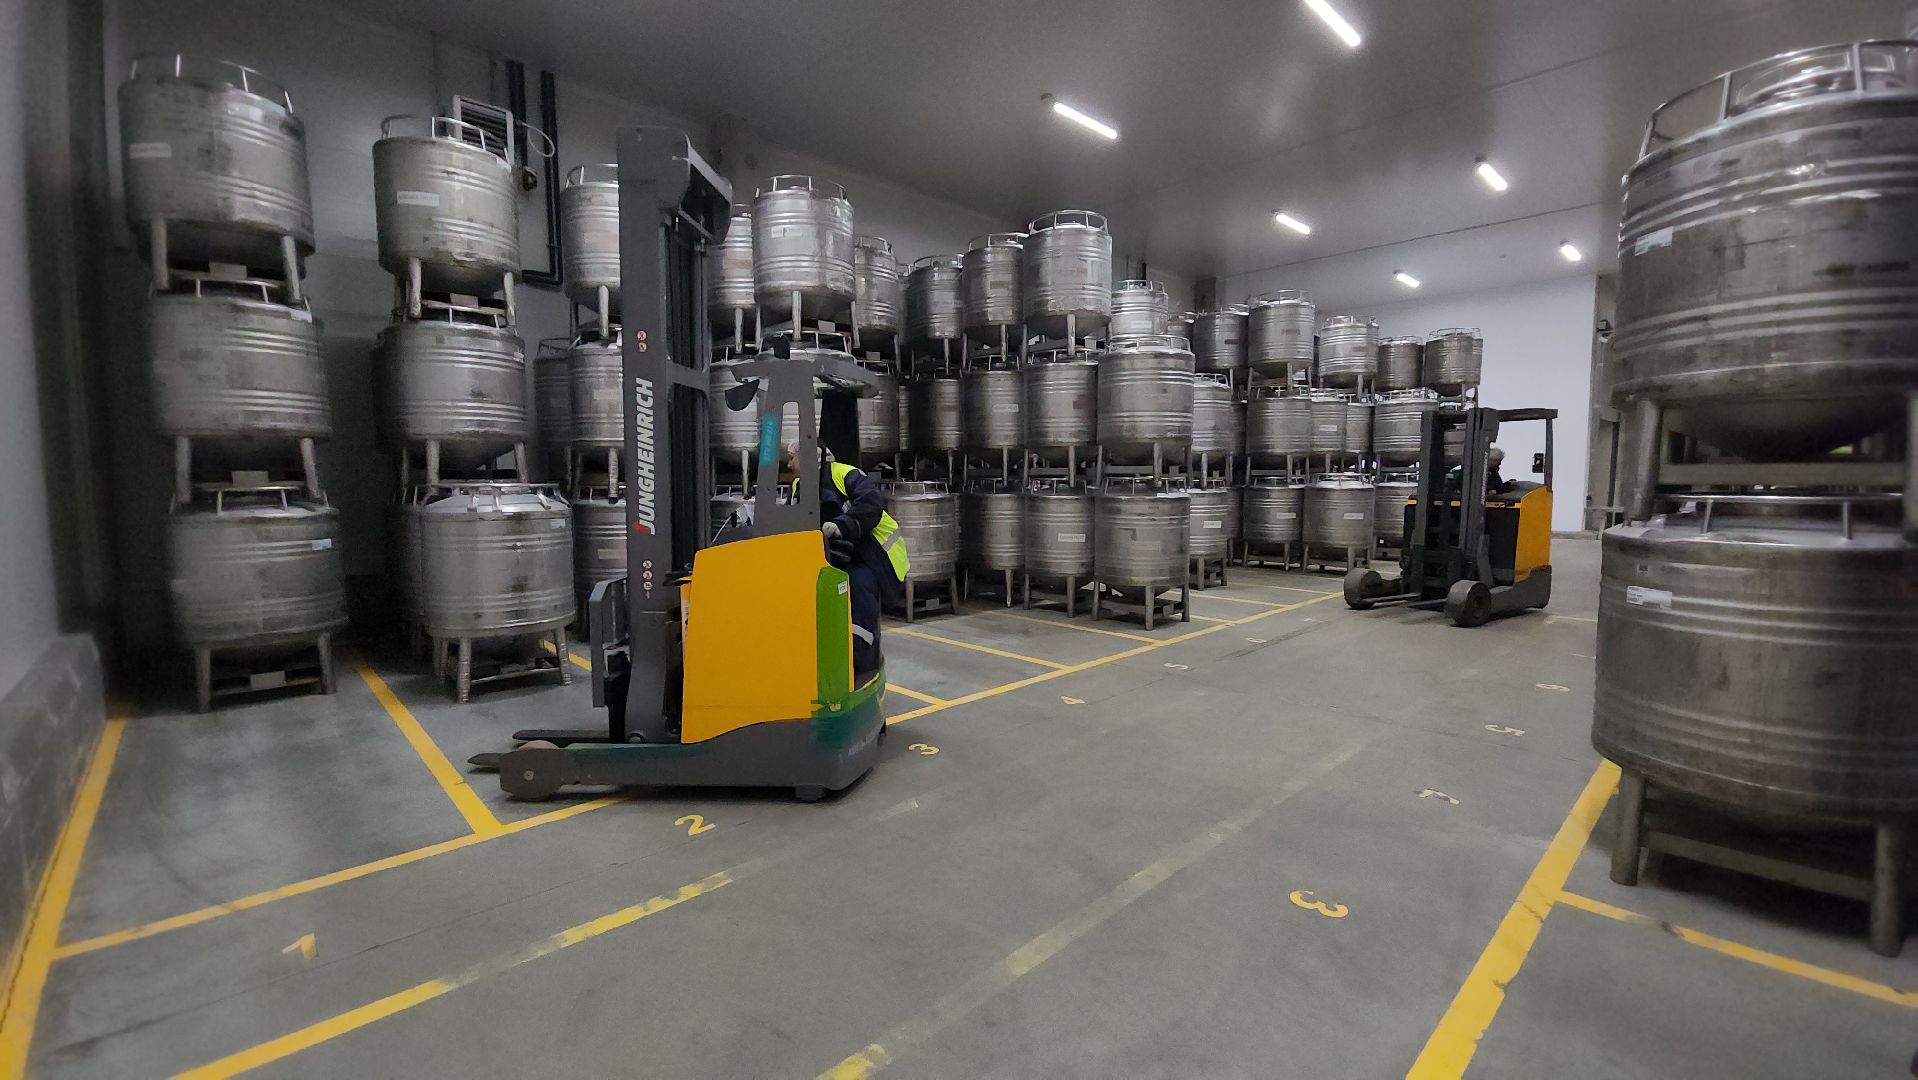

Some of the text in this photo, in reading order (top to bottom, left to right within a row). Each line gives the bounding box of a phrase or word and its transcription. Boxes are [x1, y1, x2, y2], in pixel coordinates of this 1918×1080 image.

[633, 378, 656, 535] JUNGHEINRICH
[1060, 695, 1086, 705] 4
[1484, 724, 1526, 737] 5
[908, 743, 940, 755] 3
[674, 814, 716, 836] 2
[1289, 890, 1349, 918] 3
[282, 932, 317, 961] 1
